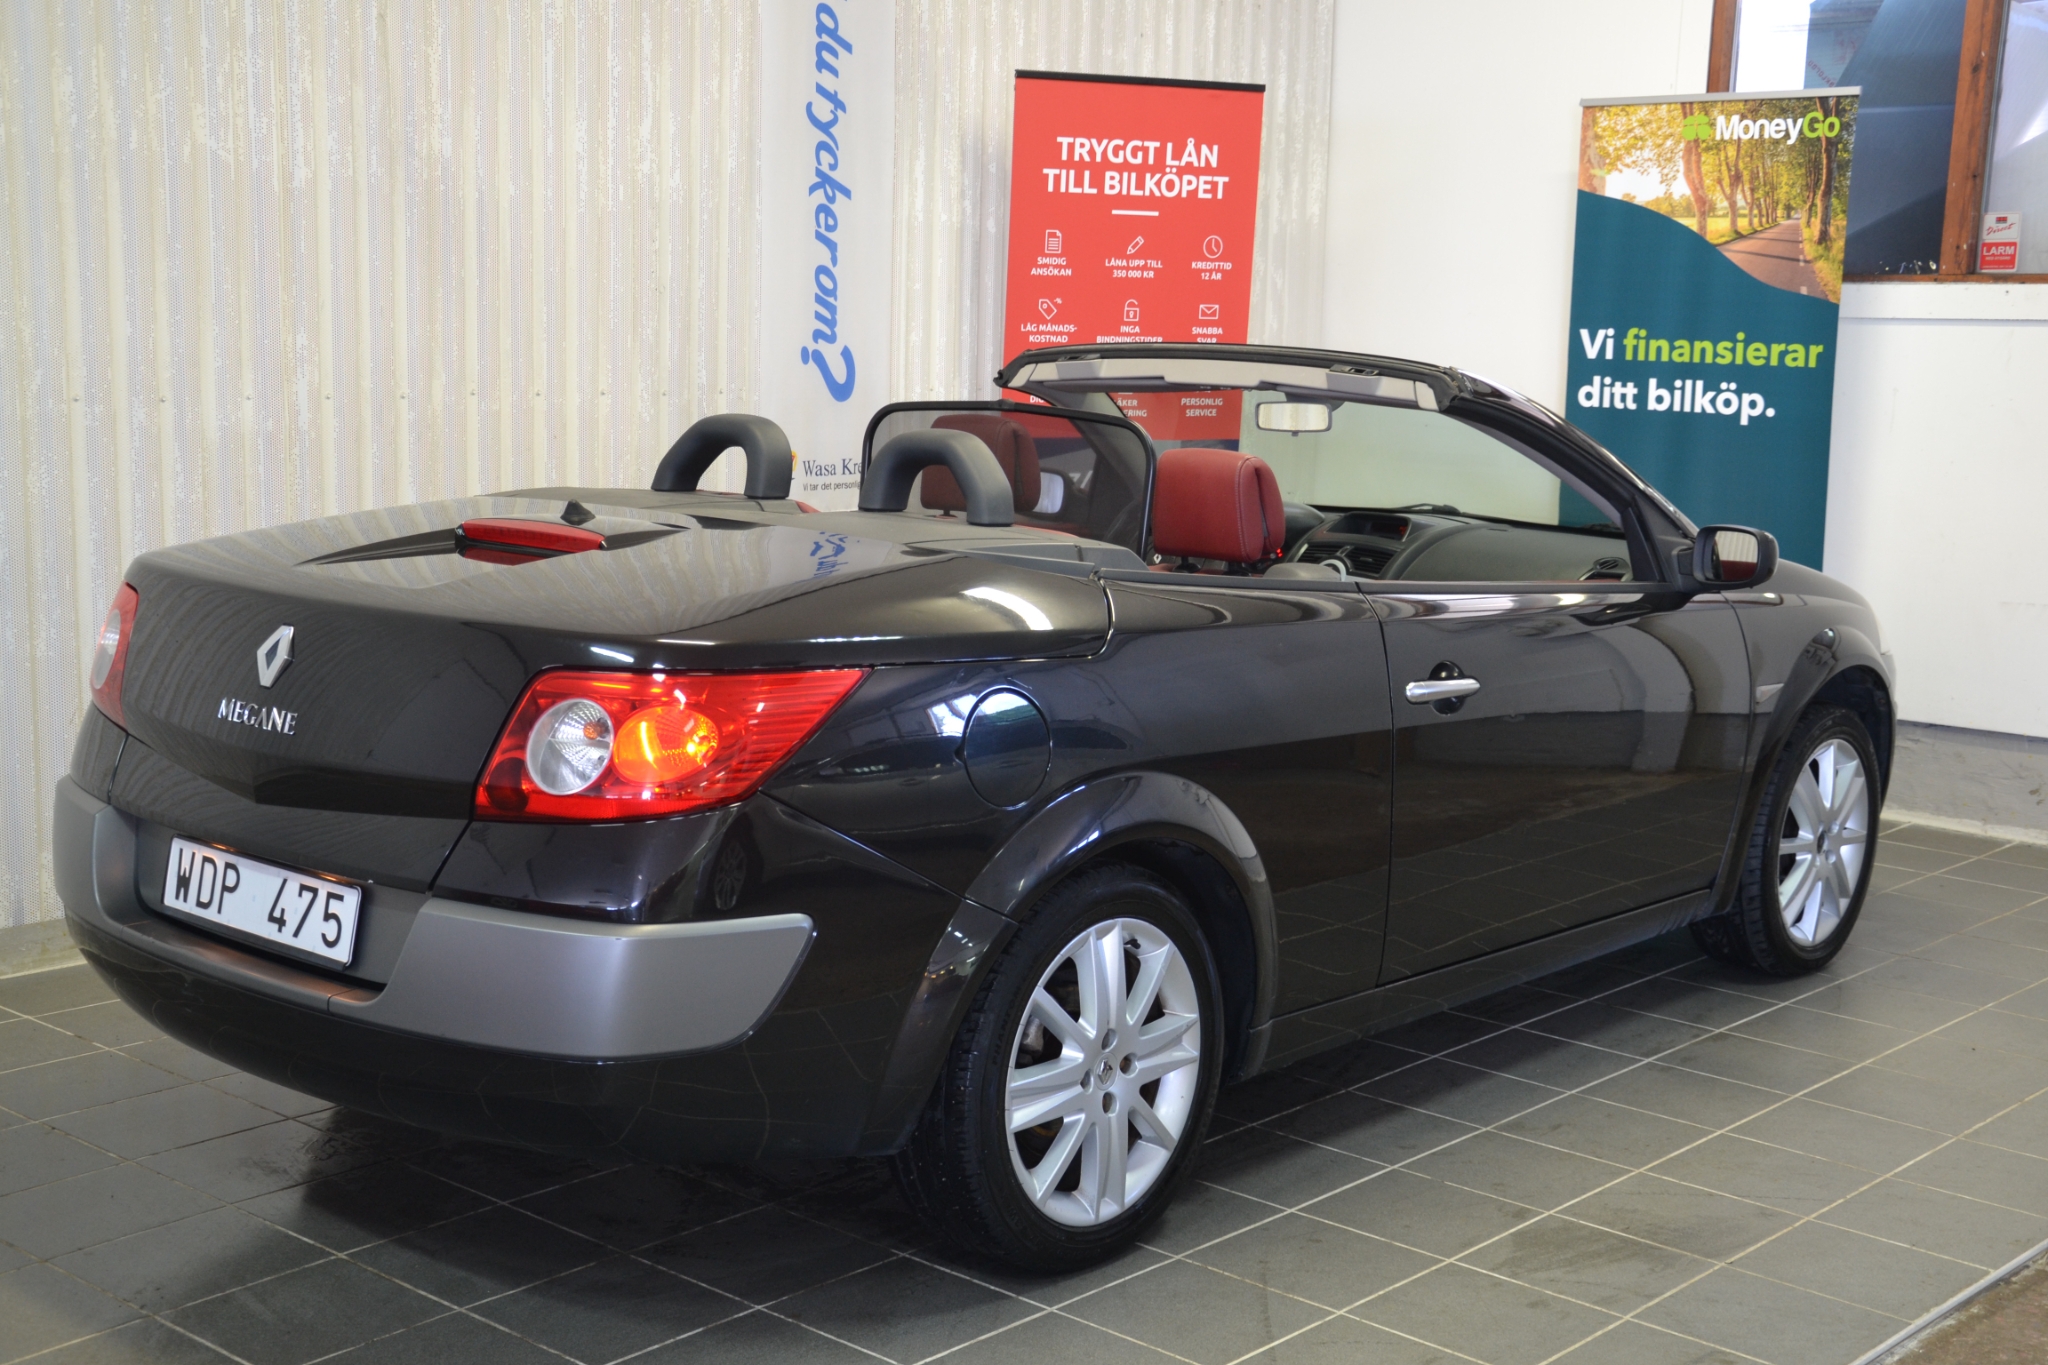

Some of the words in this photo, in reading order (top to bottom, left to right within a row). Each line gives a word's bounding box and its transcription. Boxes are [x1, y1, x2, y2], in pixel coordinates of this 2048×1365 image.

[814, 2, 853, 79] du
[1715, 111, 1841, 145] MoneyGo
[1056, 136, 1161, 165] TRYGGT
[1165, 137, 1219, 168] LÅN
[805, 81, 853, 269] tycker
[1042, 168, 1098, 194] TILL
[1104, 167, 1230, 200] BILKÖPET
[1983, 245, 2016, 256] LARM
[1037, 256, 1067, 266] SMIDIG
[1105, 257, 1127, 267] LÅNA
[1128, 259, 1145, 268] UPP
[1146, 259, 1163, 268] TILL
[1191, 261, 1232, 270] KREDITTID
[1030, 266, 1072, 277] ANSÖKAN
[1112, 269, 1127, 278] 350
[1127, 270, 1141, 278] 000
[1143, 270, 1154, 278] KR
[1200, 272, 1209, 280] 12
[1211, 271, 1222, 280] ÅR
[1020, 322, 1037, 332] LÅG
[1038, 322, 1077, 333] MÅNADS-
[1120, 325, 1140, 334] INGA
[1191, 326, 1223, 335] SNABBA
[800, 264, 857, 403] om?
[1029, 334, 1068, 343] KOSTNAD
[1096, 335, 1163, 344] BINDNINGSTIDER
[1579, 327, 1616, 360] Vi
[1622, 327, 1824, 368] finansierar
[1115, 397, 1138, 407] ÄKER
[1180, 397, 1223, 407] PERSONLIG
[1577, 375, 1638, 410] ditt
[1646, 377, 1776, 426] bilköp.
[1123, 409, 1148, 418] ERING
[1185, 408, 1217, 417] SERVICE
[802, 459, 837, 477] Wasa
[841, 458, 862, 475] Kre
[803, 483, 809, 491] Vi
[809, 483, 819, 491] tar
[820, 481, 832, 491] det
[833, 480, 861, 491] personlig
[217, 698, 298, 735] MEGANE
[174, 847, 241, 915] WDP
[267, 878, 345, 949] 475
